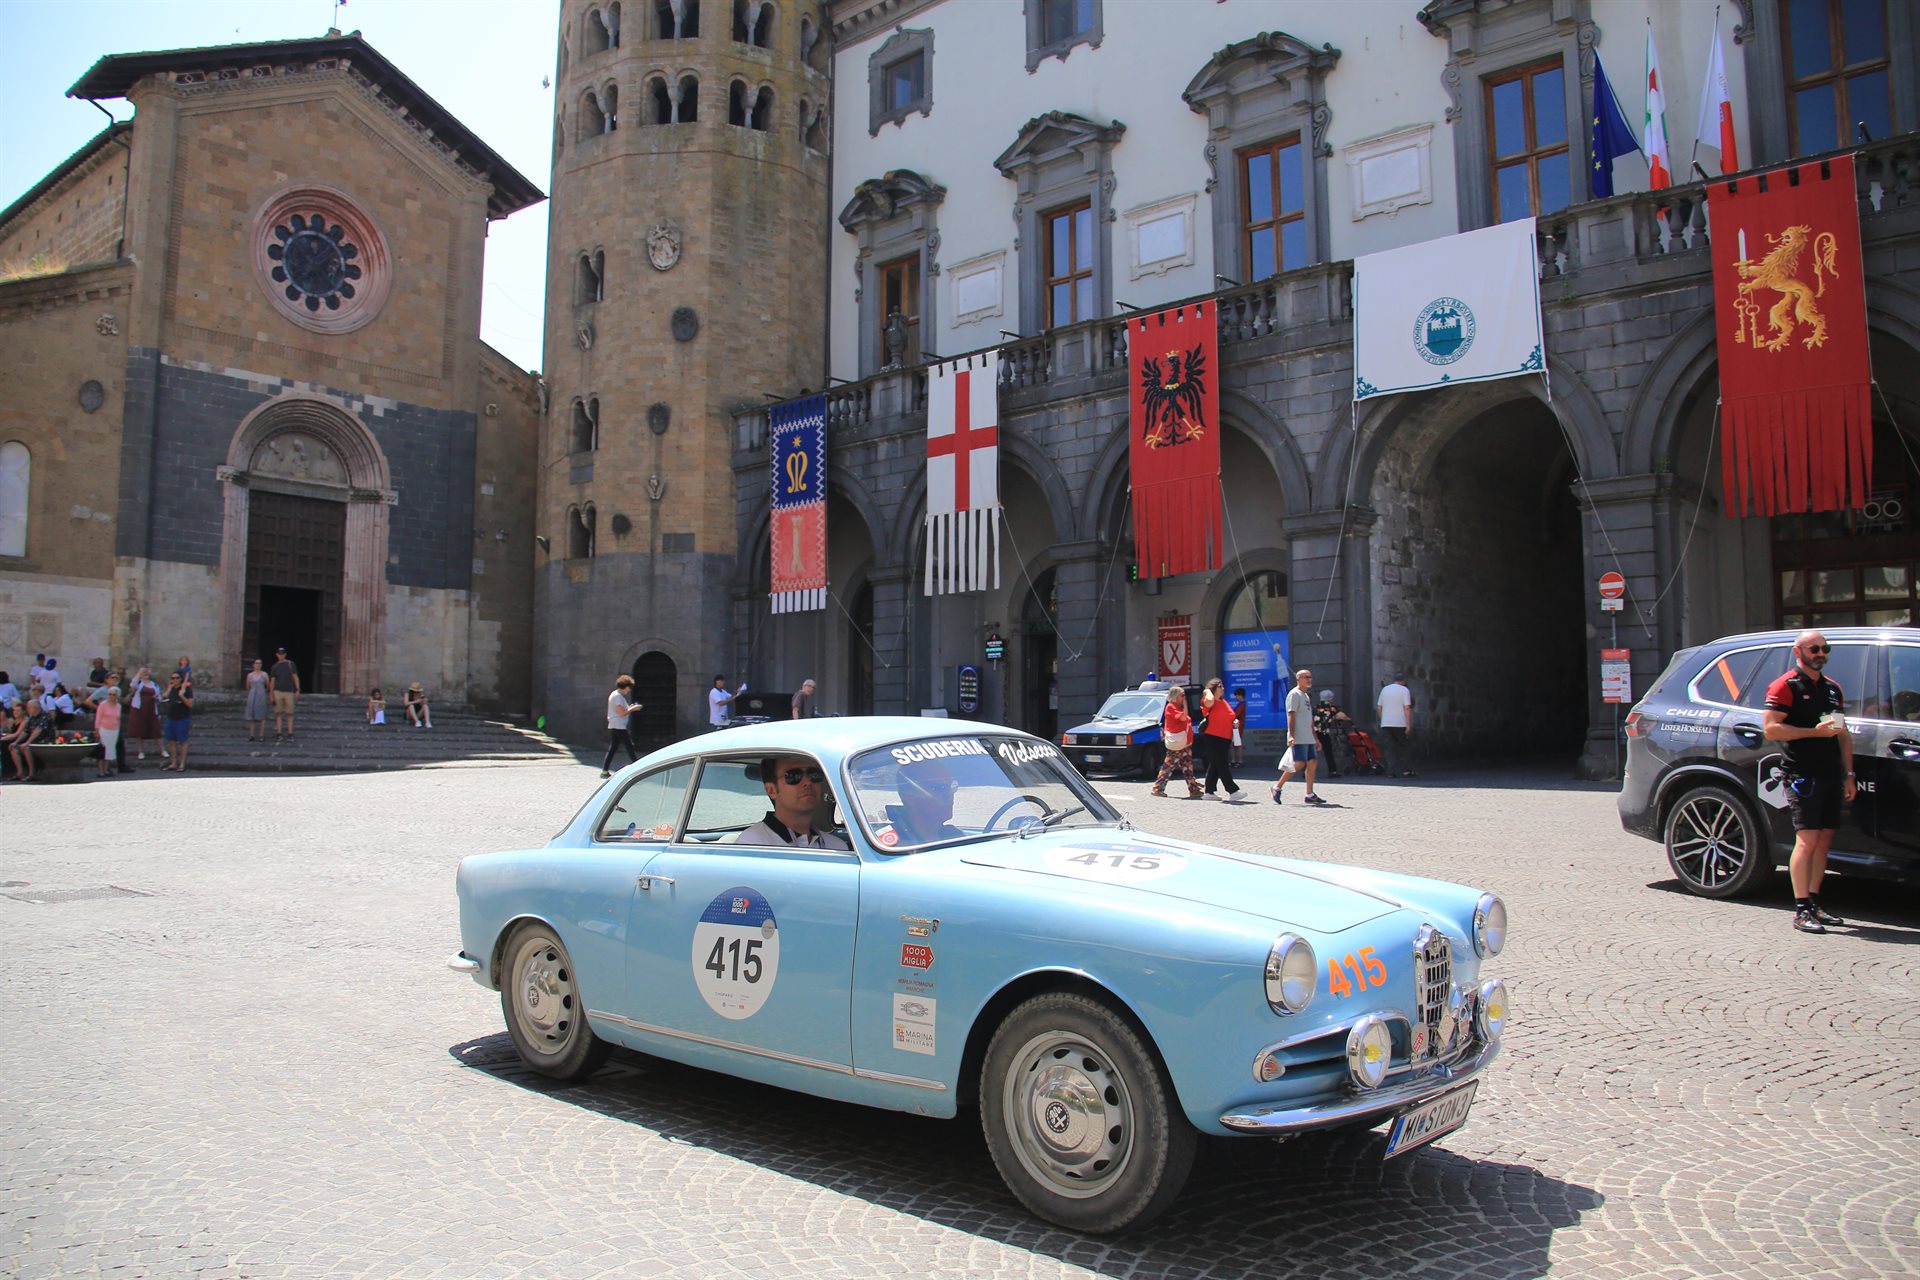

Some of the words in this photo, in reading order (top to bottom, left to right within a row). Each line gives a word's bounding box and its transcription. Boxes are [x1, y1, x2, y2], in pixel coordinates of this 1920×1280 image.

[1232, 639, 1260, 648] MIAMO
[1666, 708, 1722, 718] CHUBB
[891, 739, 989, 765] SCUDERIA
[1066, 852, 1161, 870] 415
[905, 946, 926, 956] 1000
[705, 936, 763, 984] 415
[903, 956, 927, 967] MIGLIA
[1328, 945, 1387, 998] 415
[906, 1030, 934, 1041] MARINA
[905, 1039, 933, 1047] MILITARE
[1401, 1114, 1421, 1144] MI
